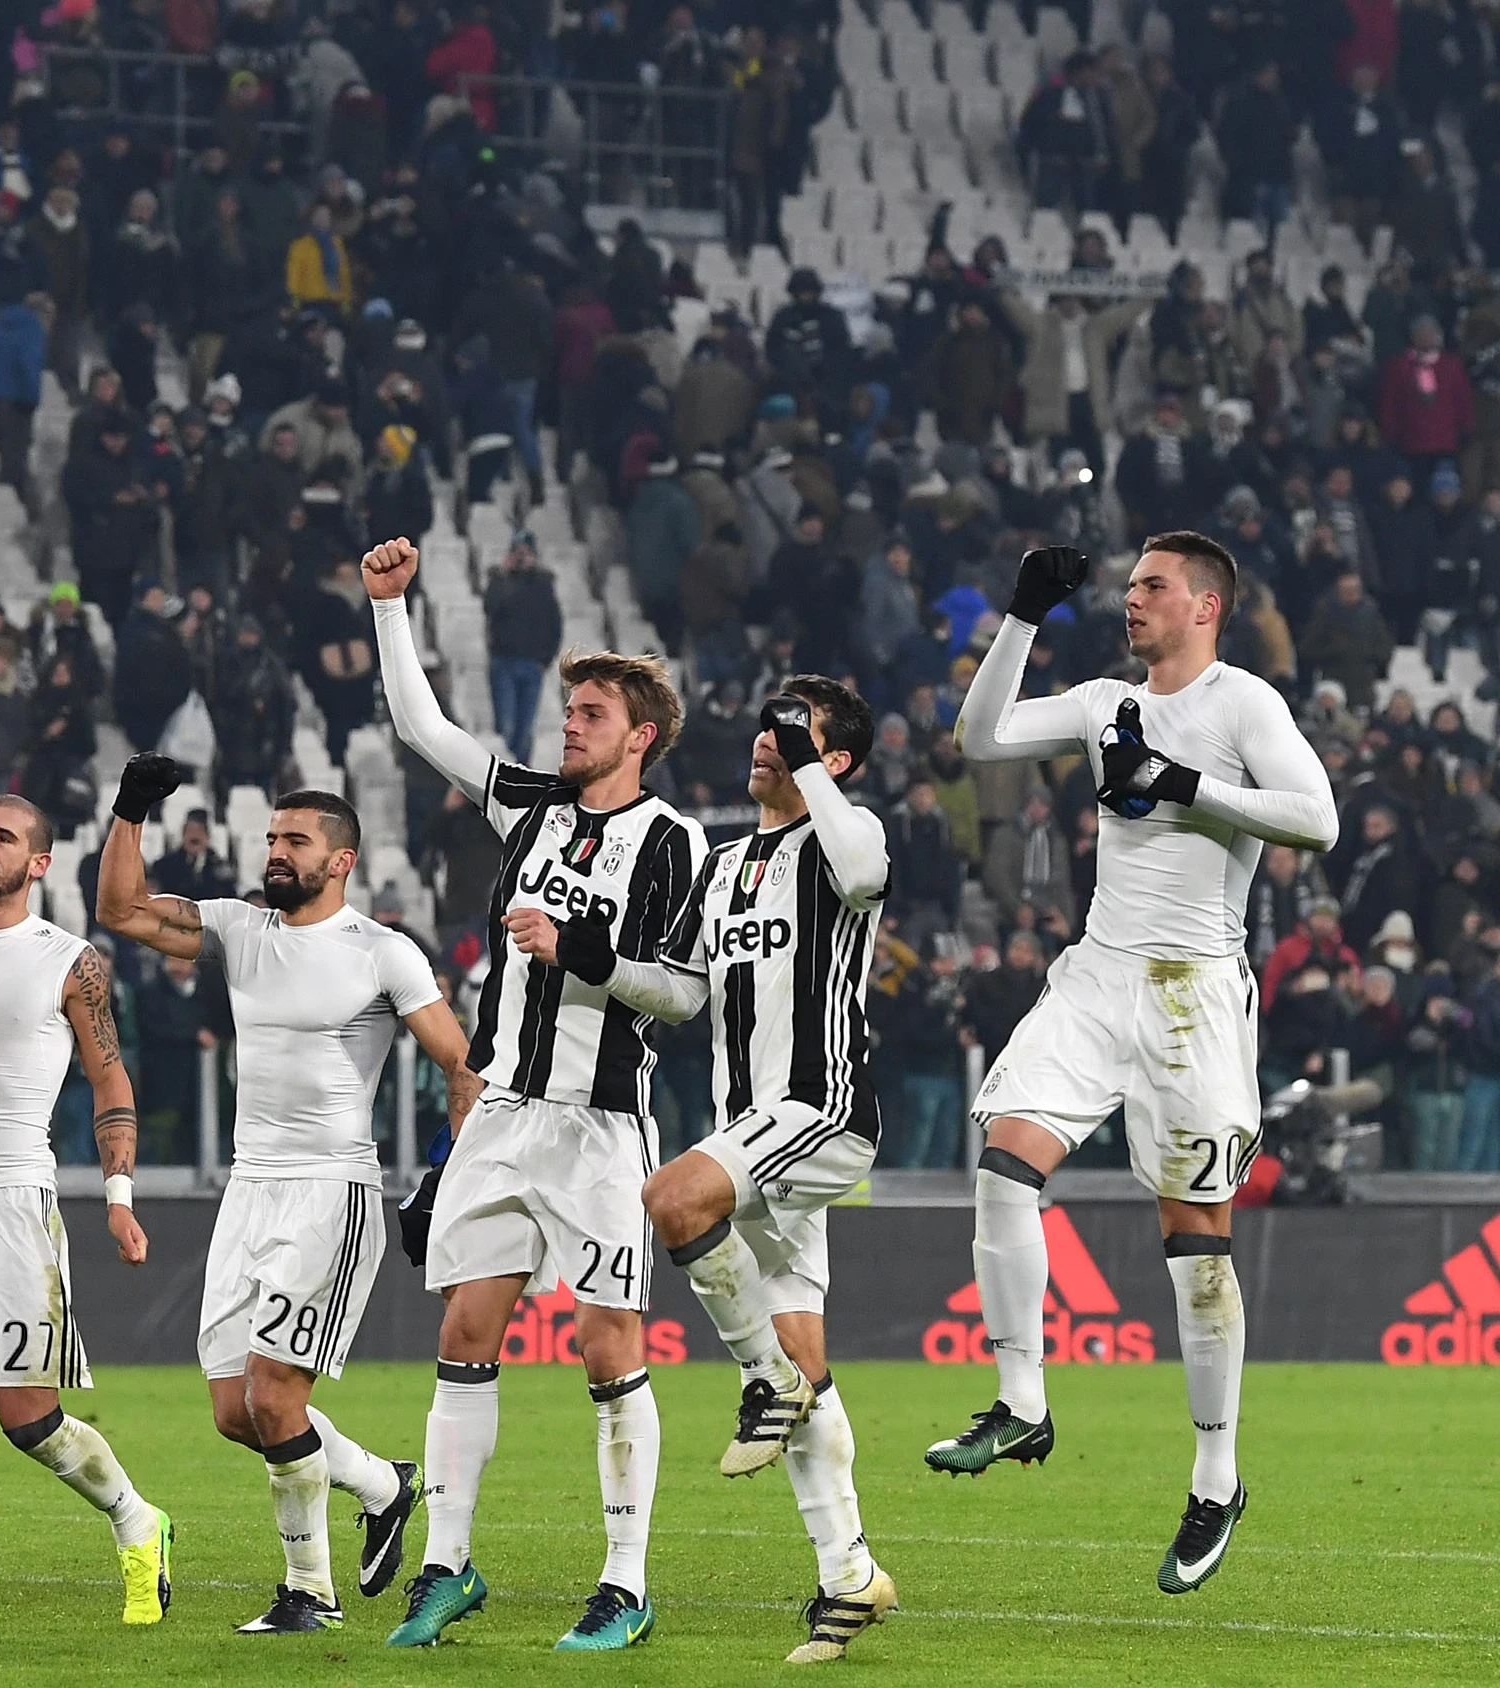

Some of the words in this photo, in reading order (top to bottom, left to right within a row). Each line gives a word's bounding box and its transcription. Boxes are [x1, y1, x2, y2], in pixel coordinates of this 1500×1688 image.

[707, 918, 791, 962] Jeep
[722, 1108, 778, 1148] 11
[1190, 1134, 1242, 1191] 20
[576, 1240, 636, 1300] 24
[3, 1321, 54, 1371] 27
[257, 1293, 318, 1356] 28
[499, 1306, 688, 1365] dis
[921, 1308, 1156, 1365] adas
[424, 1485, 446, 1497] UVE
